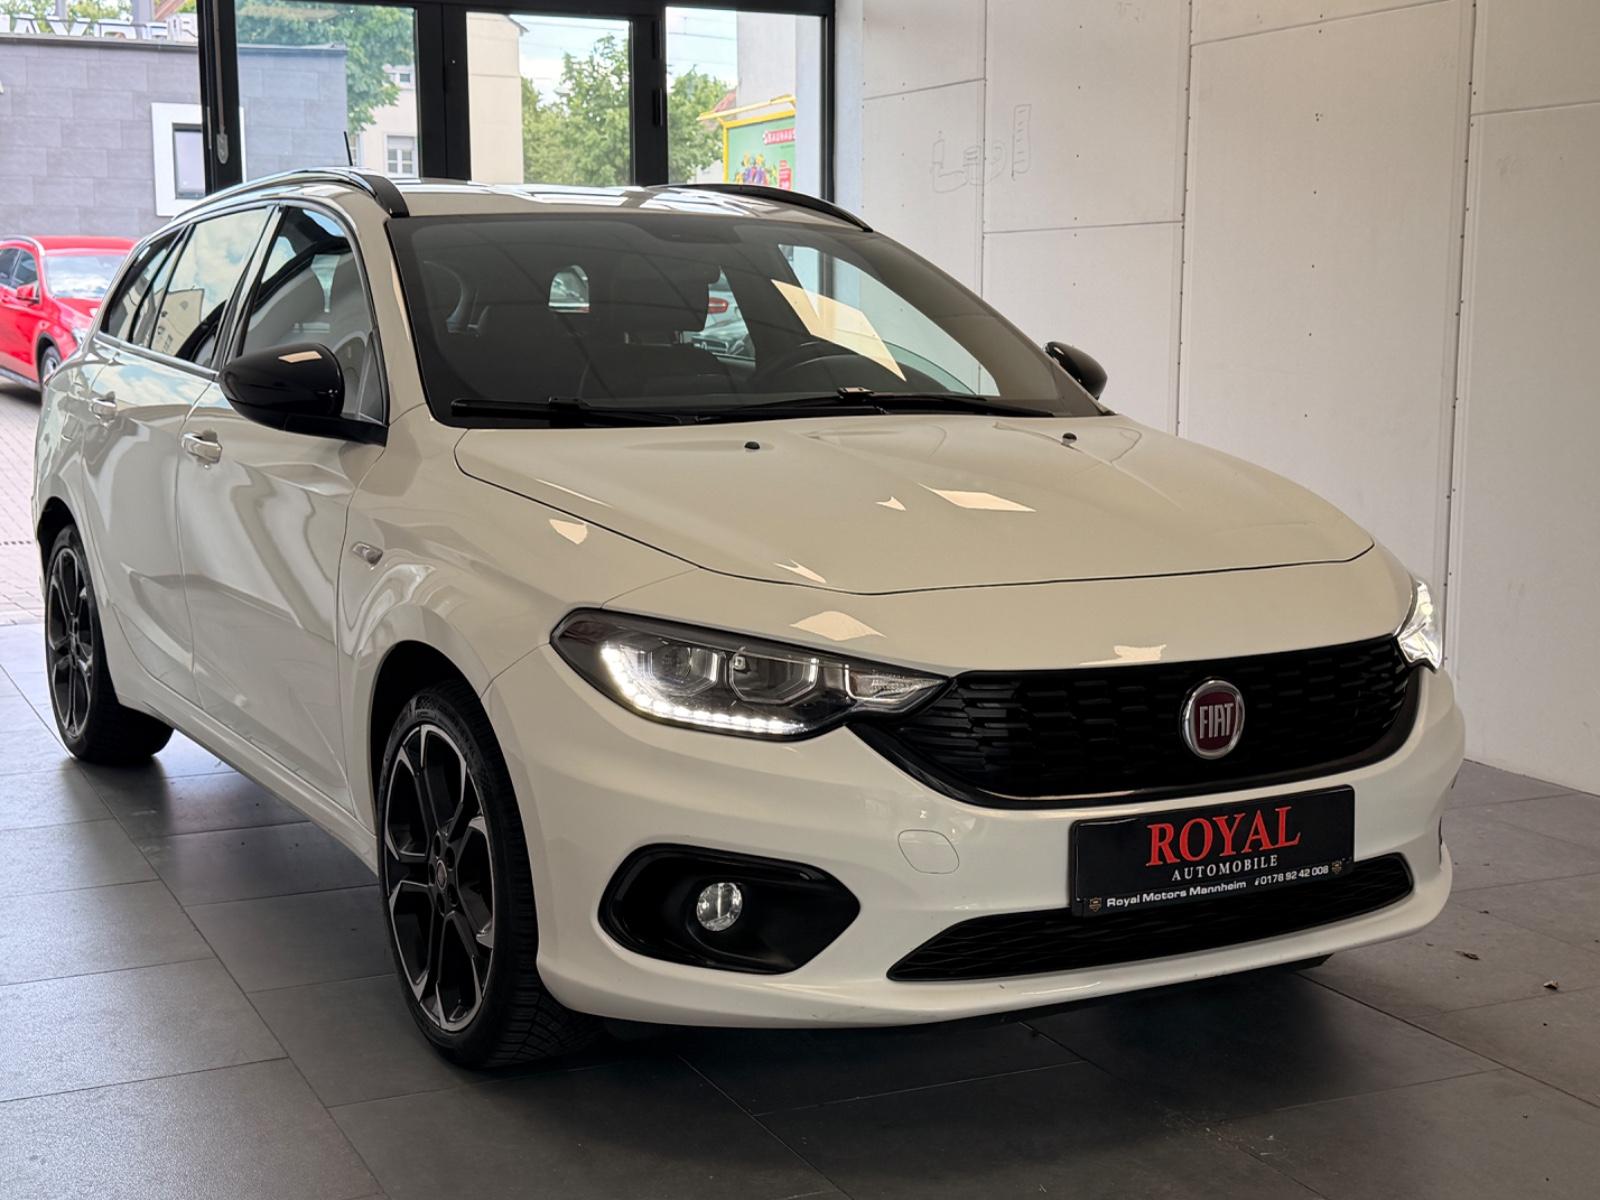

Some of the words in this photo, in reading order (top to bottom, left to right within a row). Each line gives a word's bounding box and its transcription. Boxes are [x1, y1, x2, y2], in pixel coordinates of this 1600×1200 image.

[1199, 702, 1234, 739] FIAT
[1145, 806, 1301, 867] ROYAL
[1106, 893, 1141, 909] Royal
[1142, 888, 1188, 903] Motors
[1189, 879, 1247, 896] Mannheim
[1260, 872, 1284, 886] 0178
[1298, 866, 1311, 879] 42
[1171, 854, 1279, 882] AUTOMOBILE
